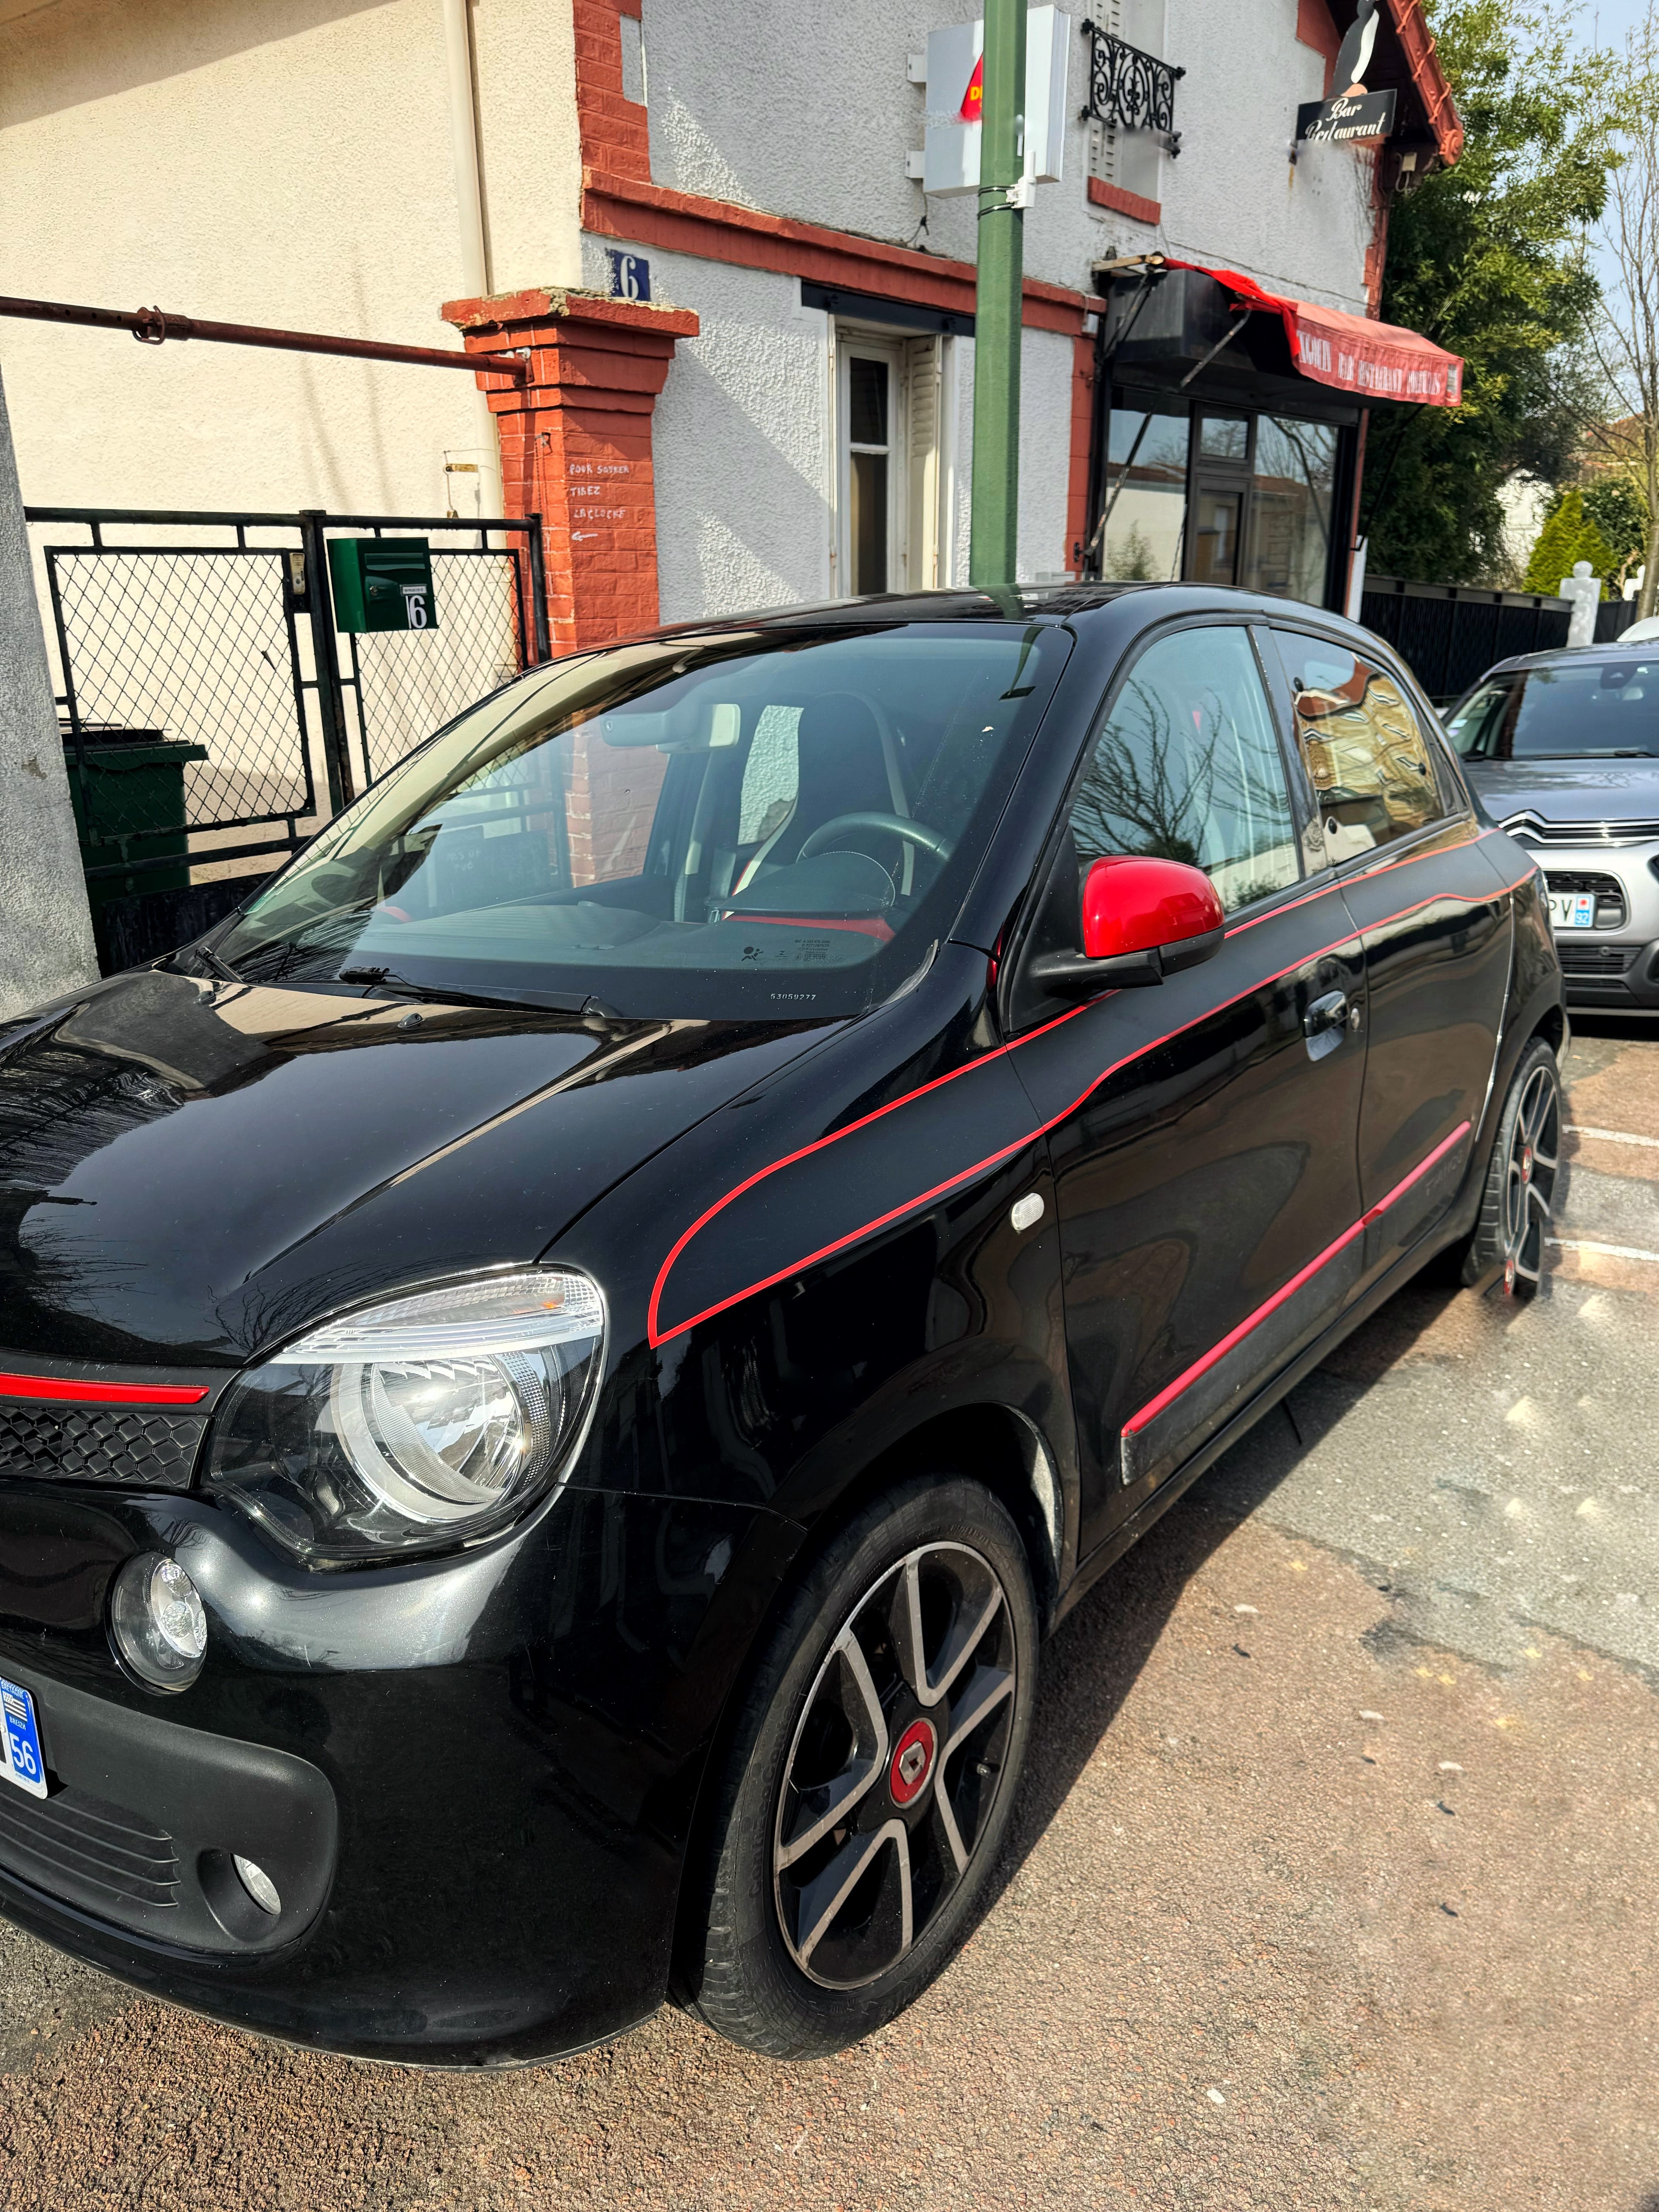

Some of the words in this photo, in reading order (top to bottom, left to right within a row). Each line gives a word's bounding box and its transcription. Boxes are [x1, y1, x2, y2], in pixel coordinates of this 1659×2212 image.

[1326, 98, 1362, 121] Bar
[620, 256, 639, 300] 6
[570, 463, 593, 475] POUR
[570, 486, 601, 497] TIREZ
[409, 595, 427, 629] 6
[9, 1732, 36, 1775] 56
